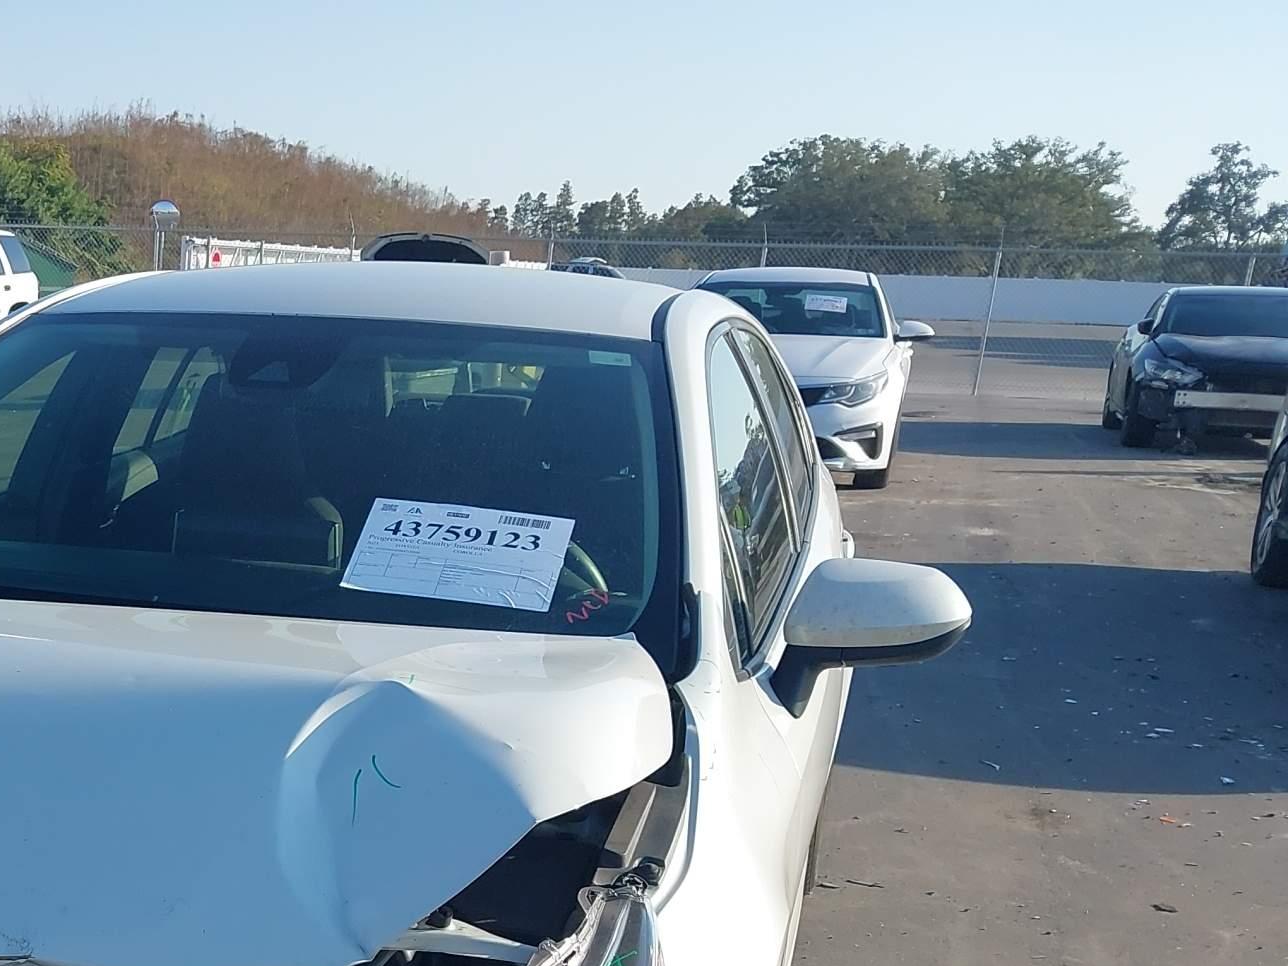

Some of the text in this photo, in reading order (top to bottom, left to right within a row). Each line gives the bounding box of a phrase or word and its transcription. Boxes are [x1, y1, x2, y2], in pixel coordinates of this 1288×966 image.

[368, 533, 415, 545] Progressive
[416, 537, 452, 548] Casualty
[454, 542, 492, 553] Insurance
[383, 519, 541, 552] 43759123
